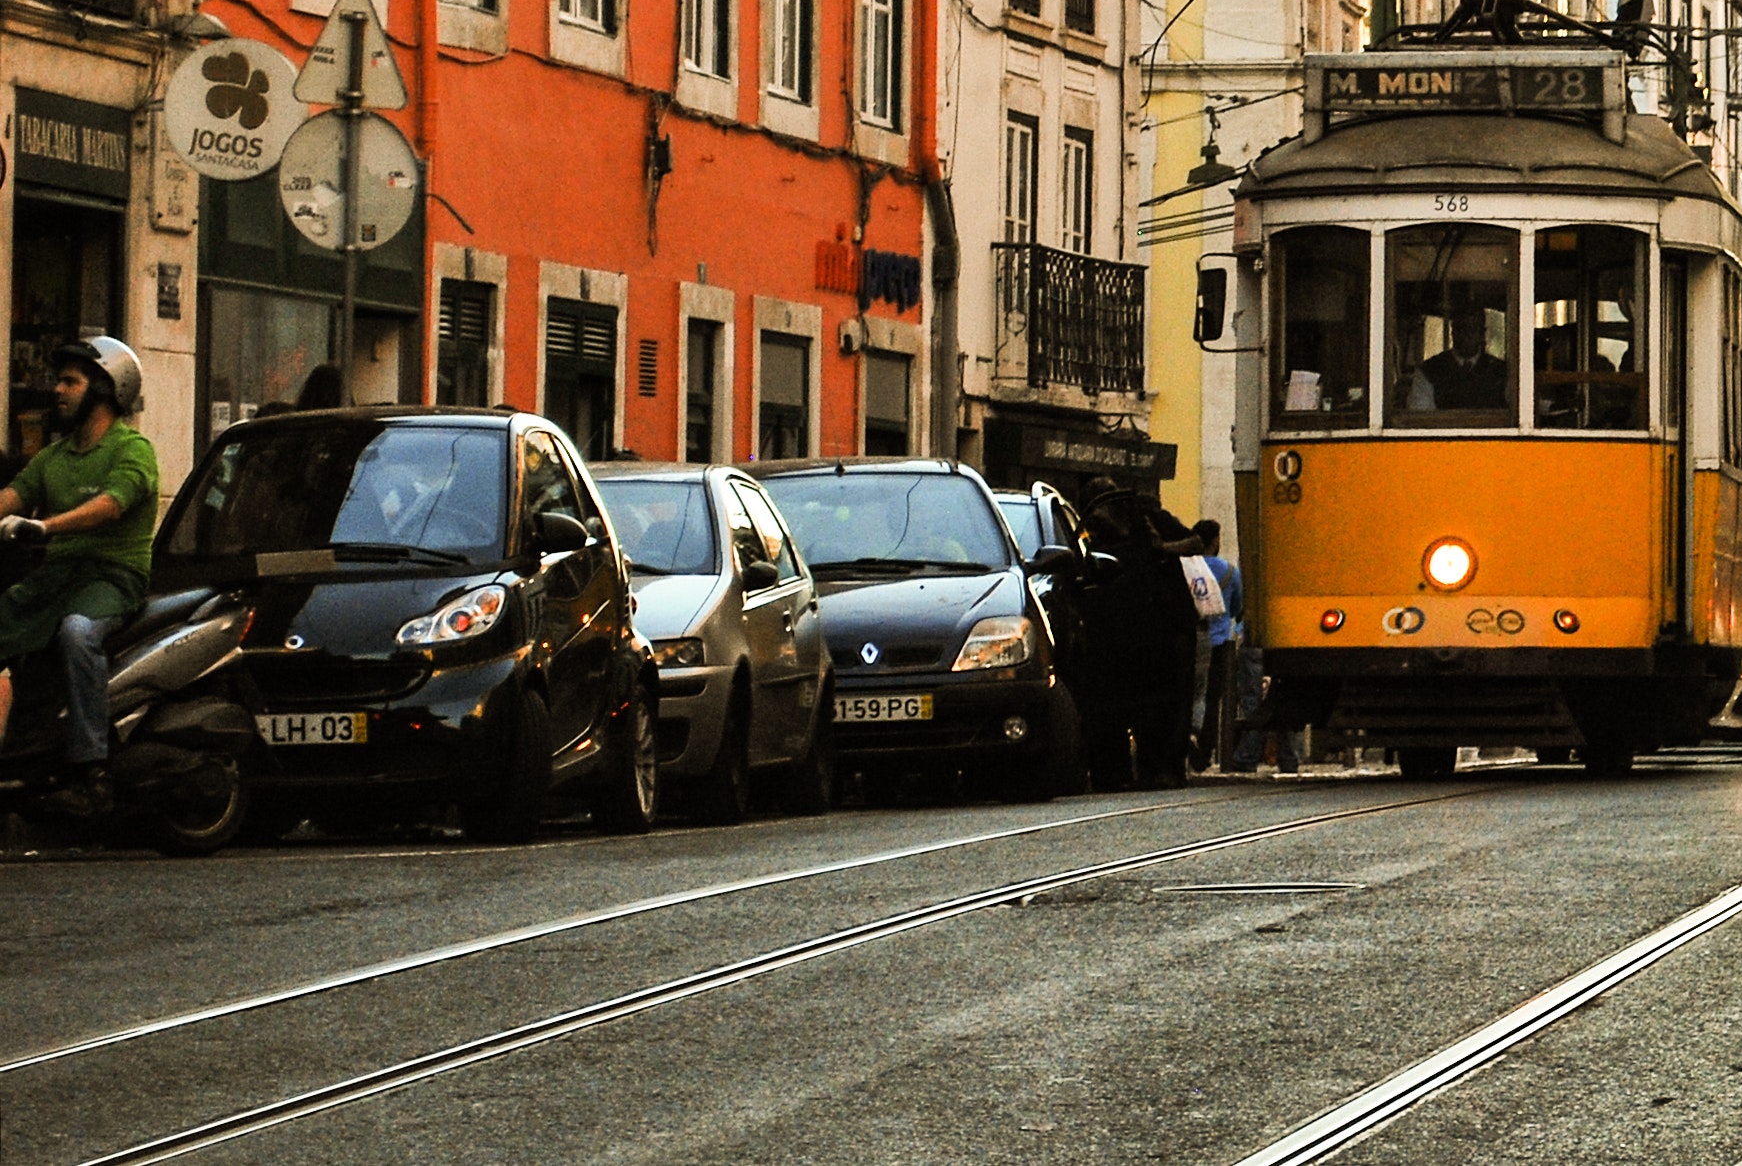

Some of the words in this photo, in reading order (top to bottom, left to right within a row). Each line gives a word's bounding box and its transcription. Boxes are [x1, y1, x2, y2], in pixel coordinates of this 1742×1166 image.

[1328, 71, 1362, 95] M.
[1533, 71, 1587, 103] 28
[187, 127, 264, 159] JOGOS
[1434, 194, 1469, 212] 568
